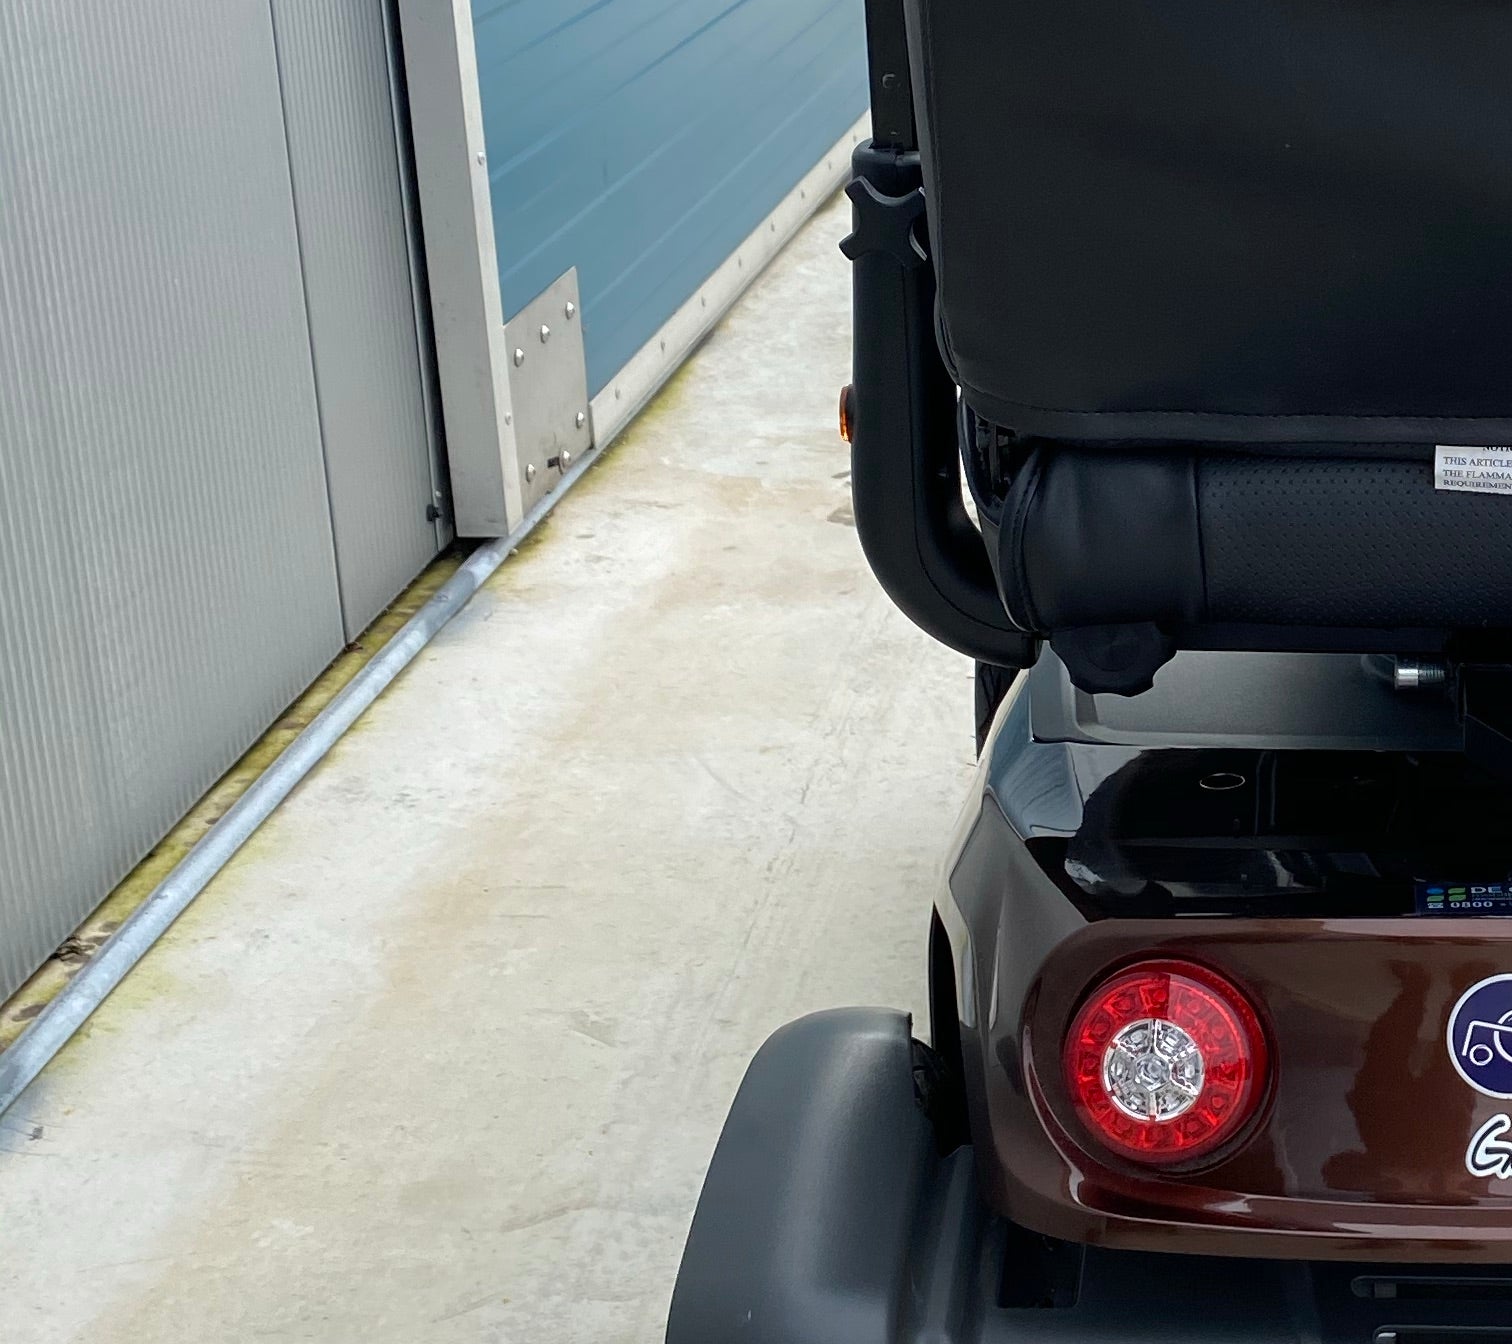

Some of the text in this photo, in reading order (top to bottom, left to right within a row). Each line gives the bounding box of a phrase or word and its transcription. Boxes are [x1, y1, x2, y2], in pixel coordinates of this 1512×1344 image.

[1443, 456, 1467, 466] THIS
[1469, 458, 1512, 468] ARTICLE
[1443, 469, 1464, 478] THE
[1470, 886, 1503, 894] DE
